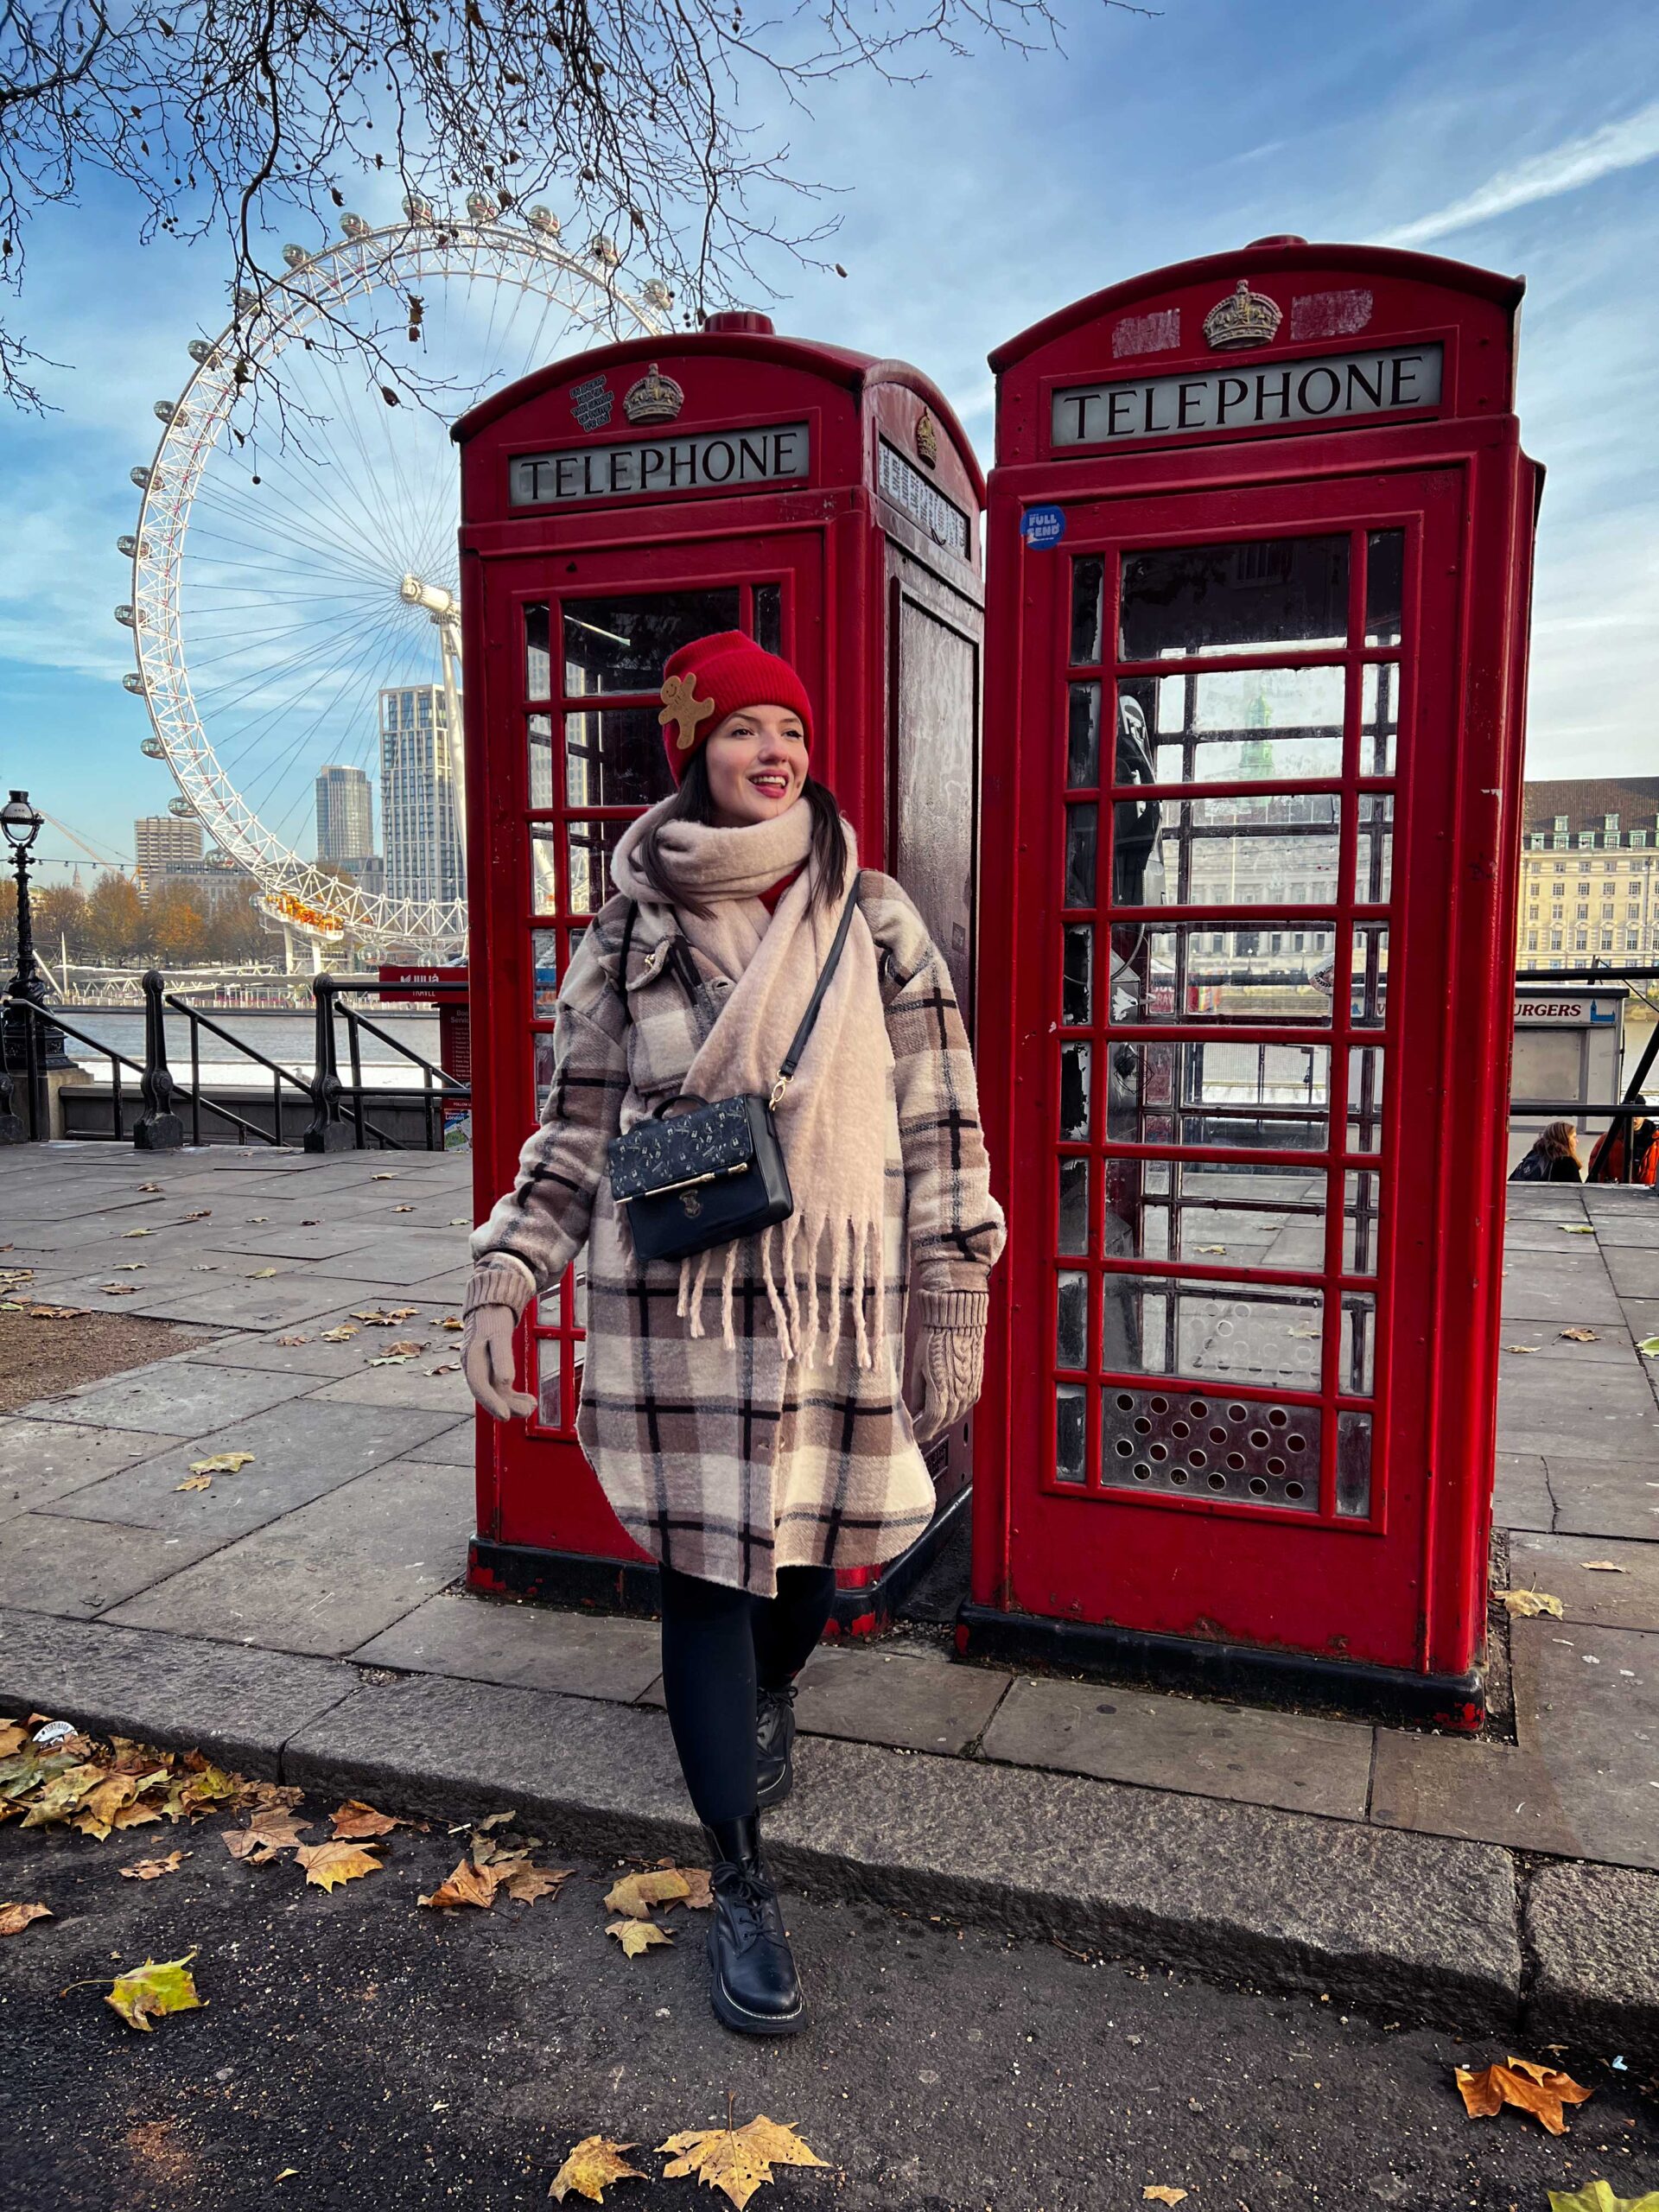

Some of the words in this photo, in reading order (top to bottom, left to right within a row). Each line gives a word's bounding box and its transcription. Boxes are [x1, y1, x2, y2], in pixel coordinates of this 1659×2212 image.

[1064, 356, 1424, 439] TELEPHONE
[520, 432, 798, 499] TELEPHONE
[1028, 514, 1057, 526] FULL
[1514, 1004, 1581, 1016] URGERS
